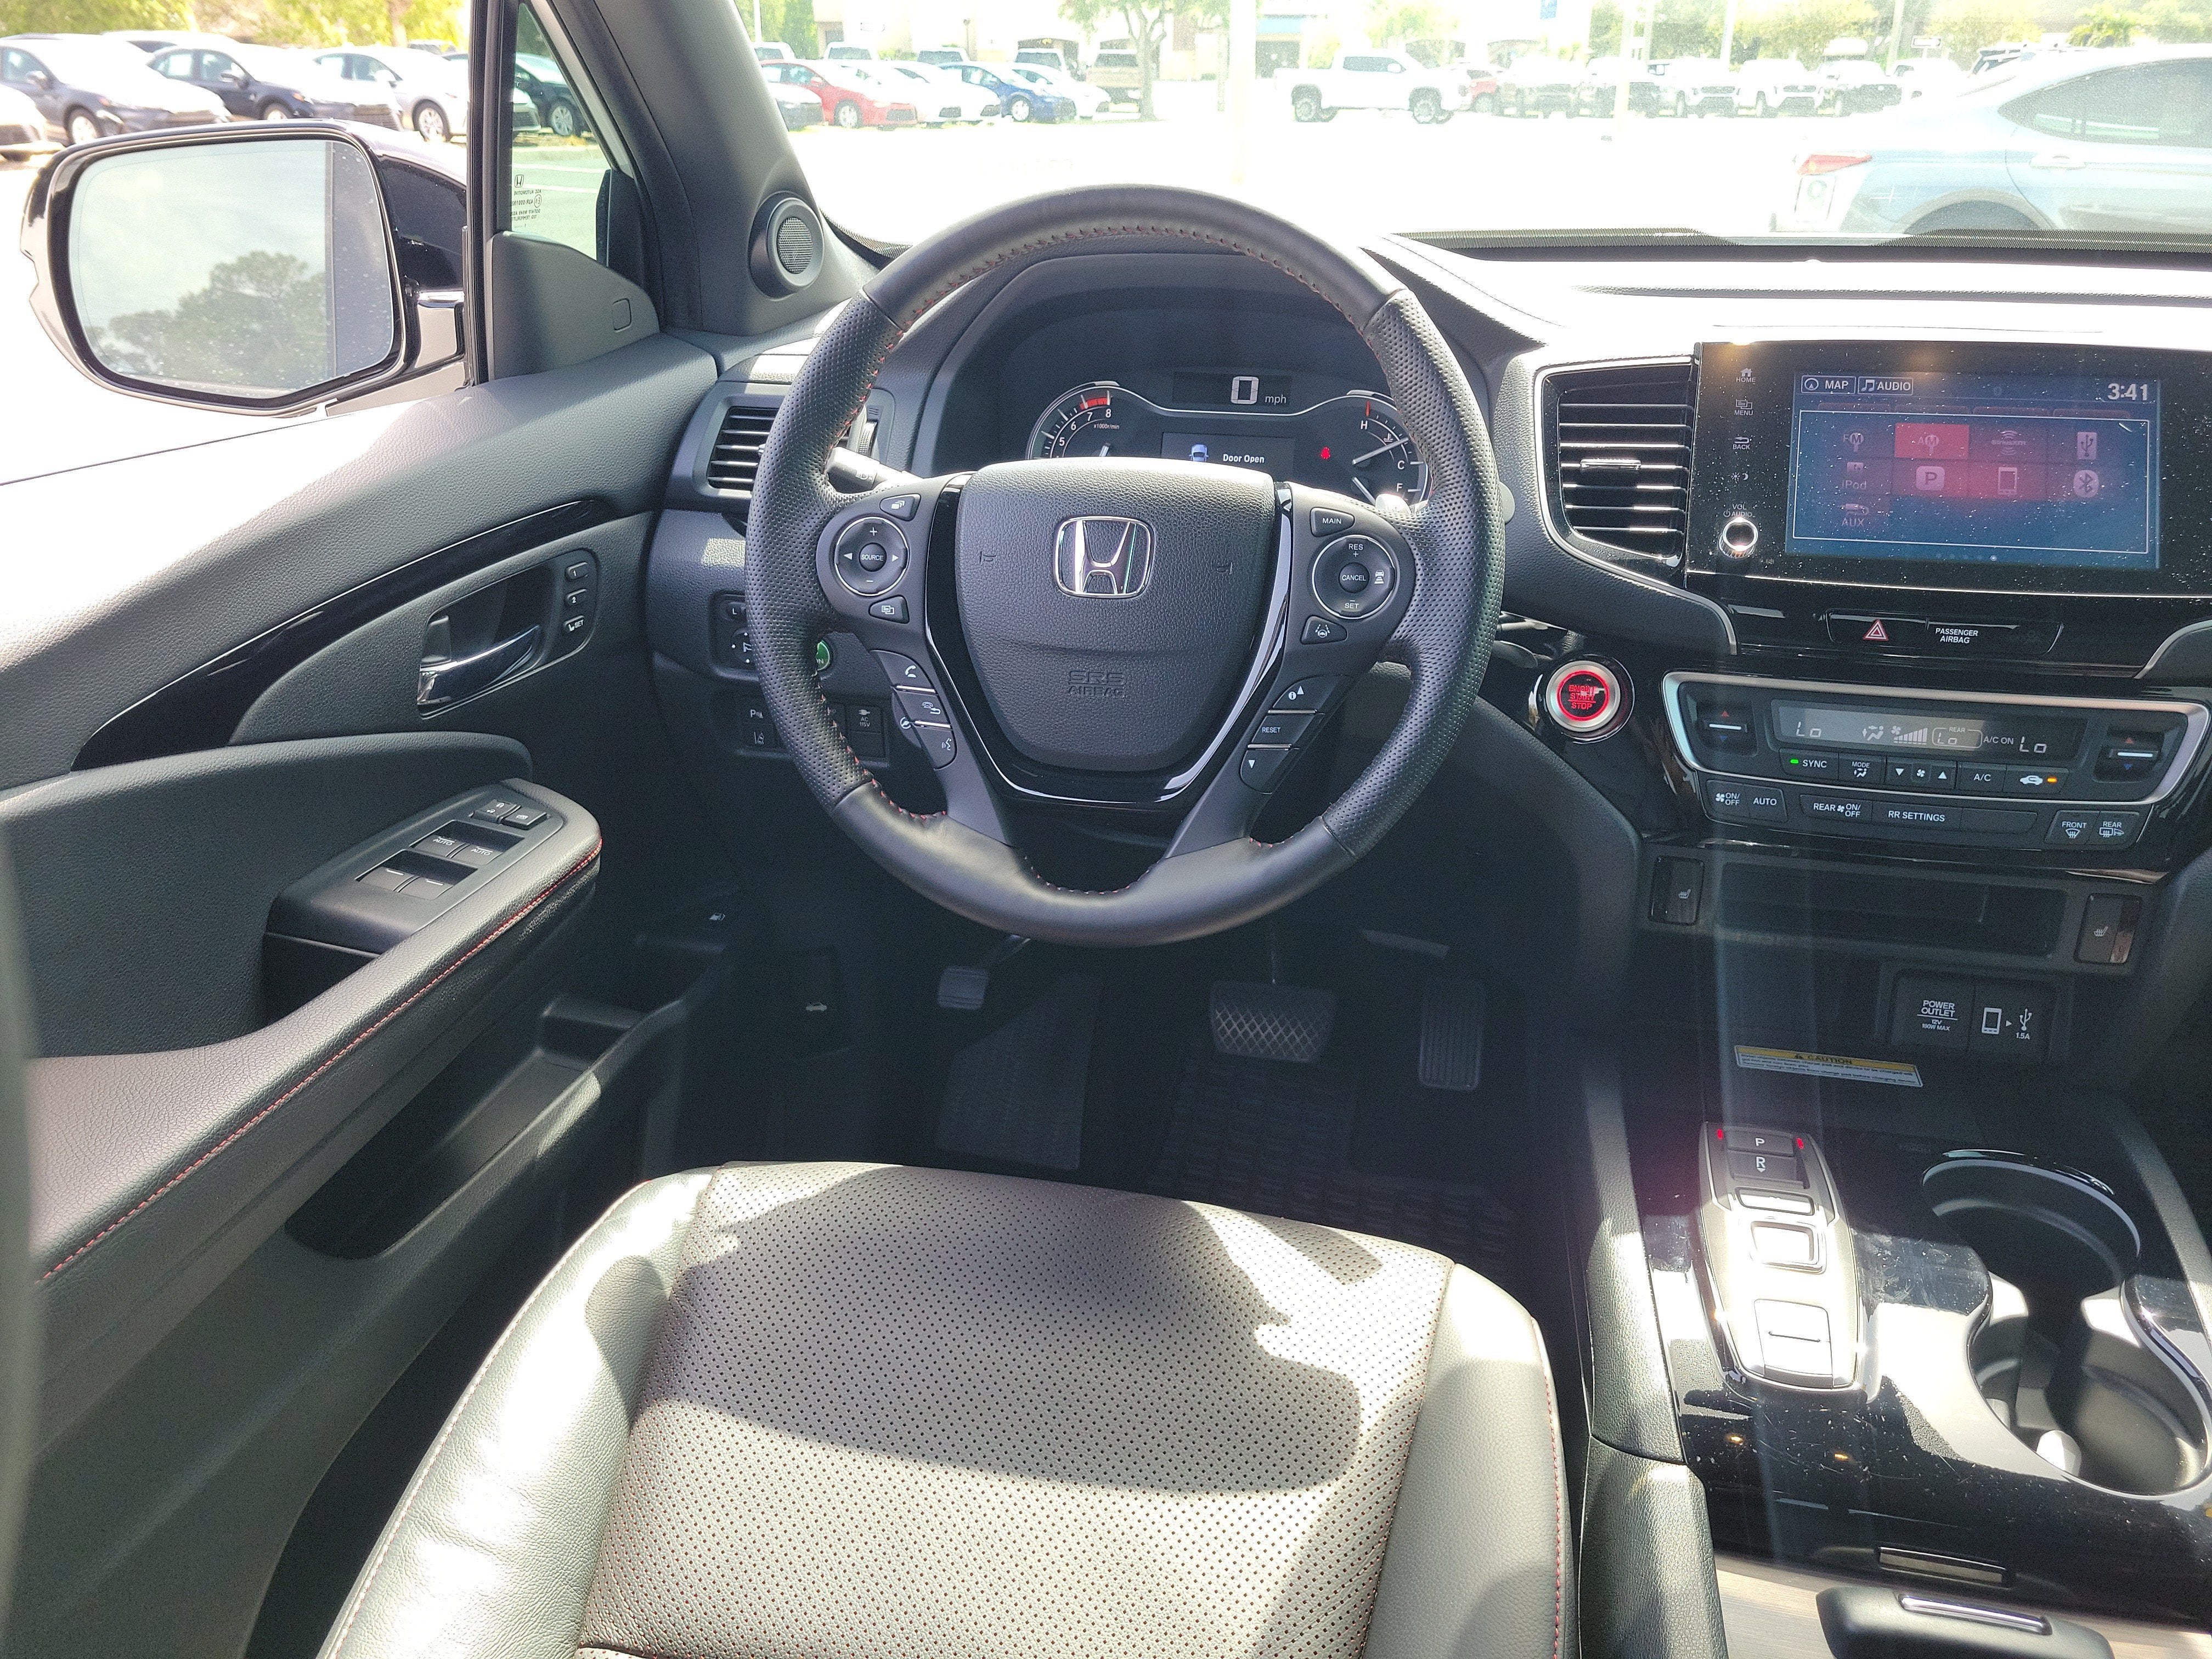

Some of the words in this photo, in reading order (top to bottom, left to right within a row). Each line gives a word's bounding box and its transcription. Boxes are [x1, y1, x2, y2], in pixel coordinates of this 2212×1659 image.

[1825, 381, 1848, 389] MAP
[1876, 381, 1911, 391] AUDIO
[1231, 376, 1259, 404] 0
[1265, 395, 1286, 405] mph
[2108, 383, 2147, 400] 3:41
[1087, 412, 1093, 421] 7
[1105, 409, 1111, 418] 8
[1071, 421, 1076, 431] 6
[1361, 421, 1368, 430] H
[1059, 437, 1065, 447] 5
[1223, 454, 1242, 462] Door
[1244, 455, 1265, 464] Open
[1397, 461, 1405, 470] C
[1397, 483, 1403, 492] F
[1842, 480, 1867, 490] iPod
[1842, 518, 1865, 527] AUX
[574, 619, 584, 628] SET
[1935, 628, 1978, 636] PASSENGER
[1940, 635, 1970, 644] AIRBAG
[1069, 670, 1125, 685] SRS
[1069, 685, 1125, 696] AIRBAG
[2001, 737, 2014, 745] ON
[1802, 759, 1827, 769] SYNC
[1973, 774, 1991, 782] A/C
[1753, 797, 1777, 806] AUTO
[1813, 803, 1836, 811] REAR
[1888, 810, 1900, 819] RR
[1902, 812, 1945, 822] SETTINGS
[1923, 1000, 1955, 1010] POWER
[1921, 1007, 1955, 1017] OUTLET
[1807, 1054, 1852, 1065] CAUTION
[1755, 1137, 1765, 1147] P
[1756, 1156, 1766, 1169] R
